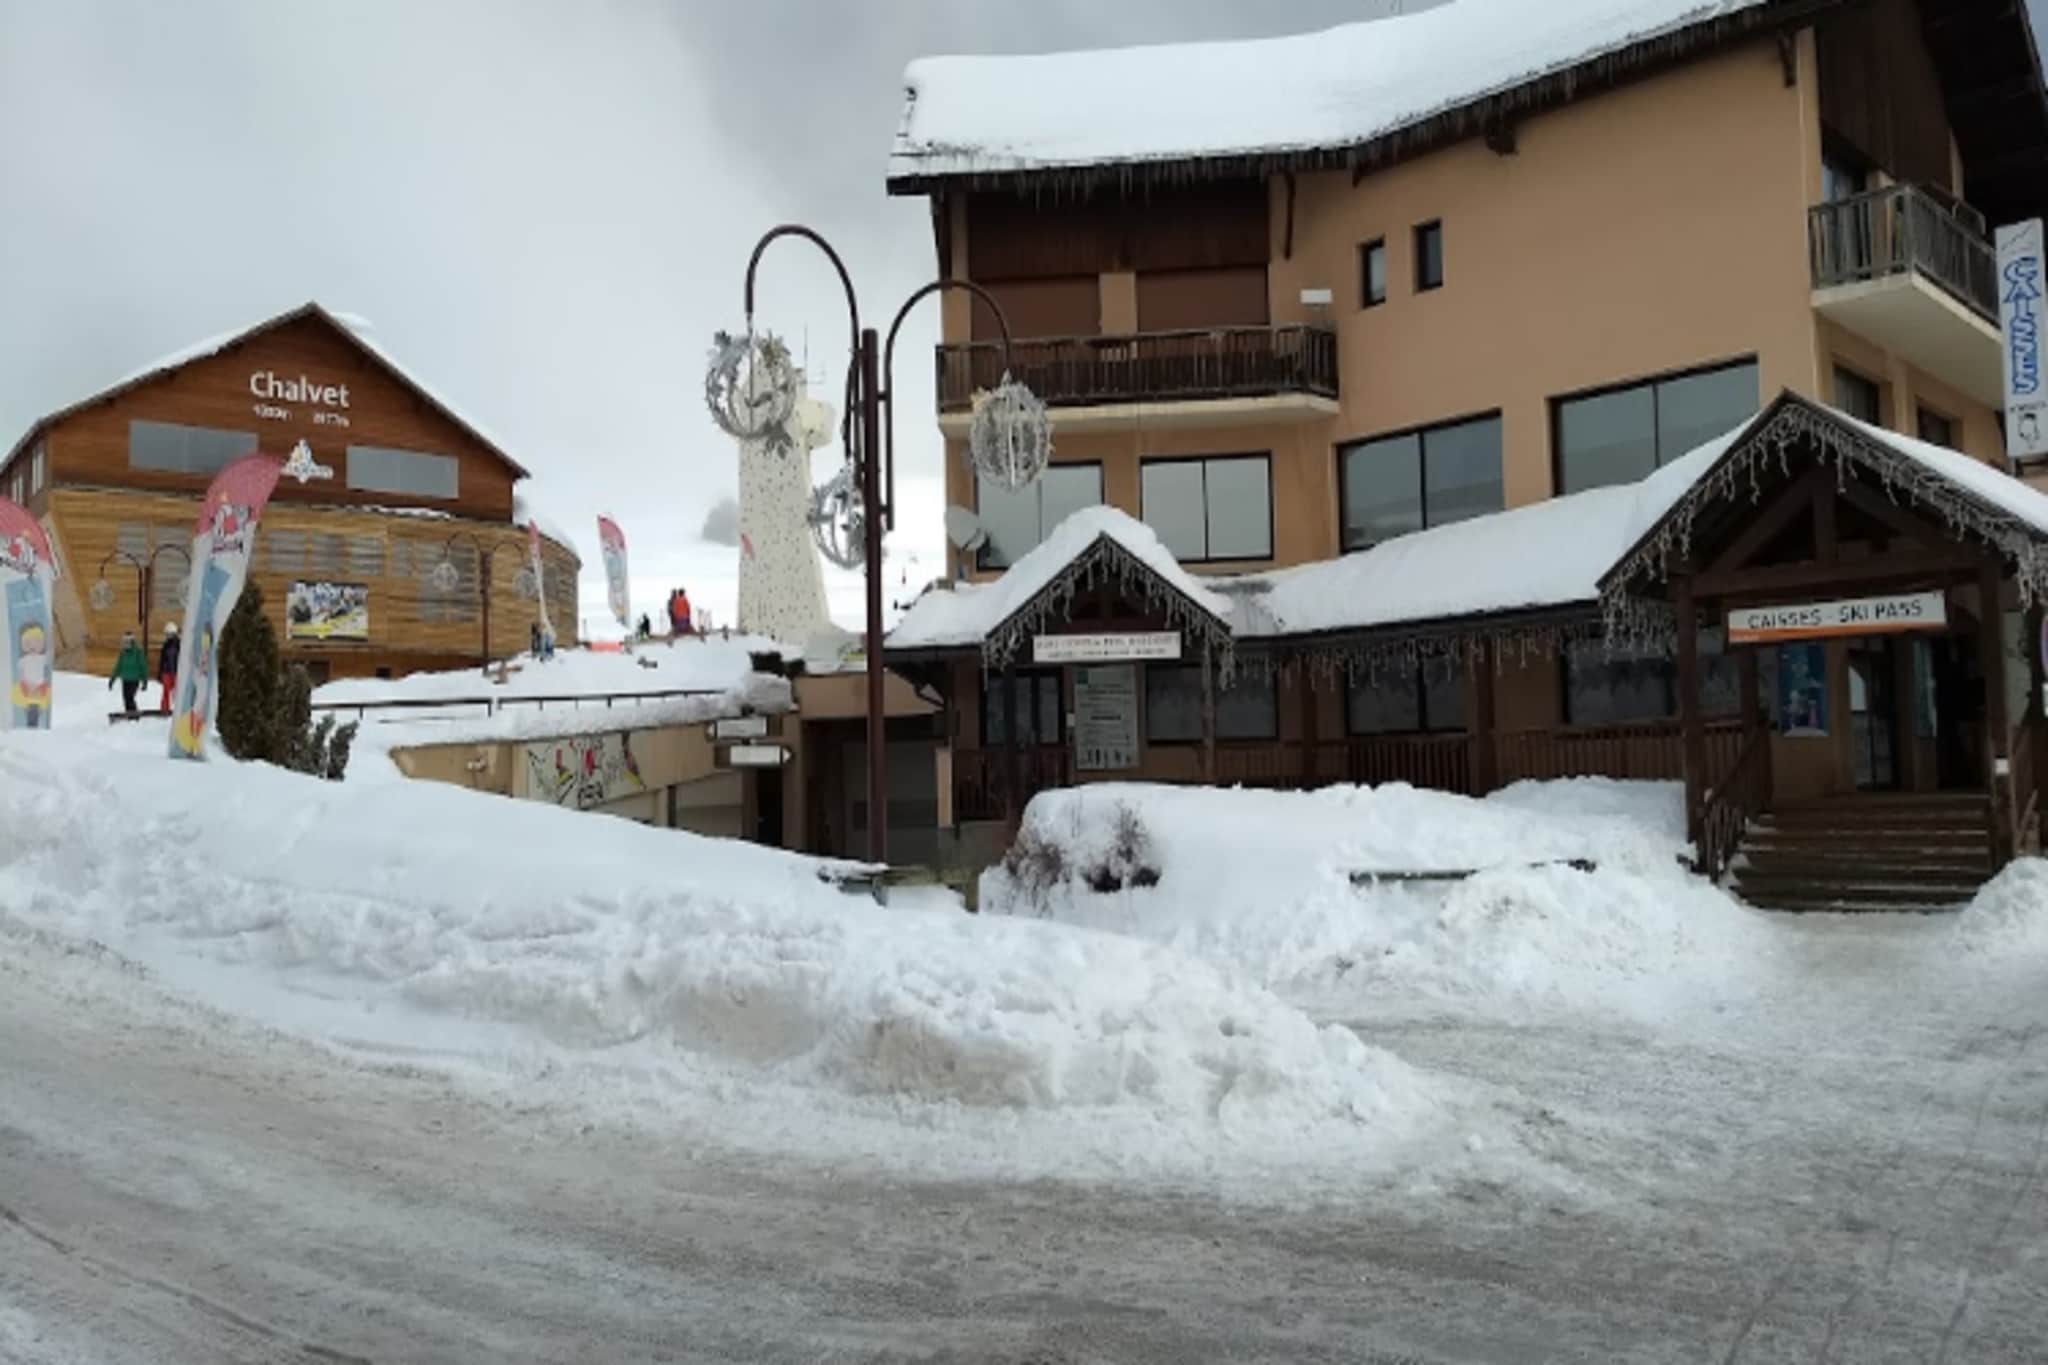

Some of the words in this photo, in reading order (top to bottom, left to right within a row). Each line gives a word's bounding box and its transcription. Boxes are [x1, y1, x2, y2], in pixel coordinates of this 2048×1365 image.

[2003, 256, 2041, 395] CAISSES
[250, 371, 350, 408] Chalvet
[1748, 609, 1821, 629] CAISSES
[1839, 606, 1869, 623] SKI
[1875, 600, 1922, 619] PASS
